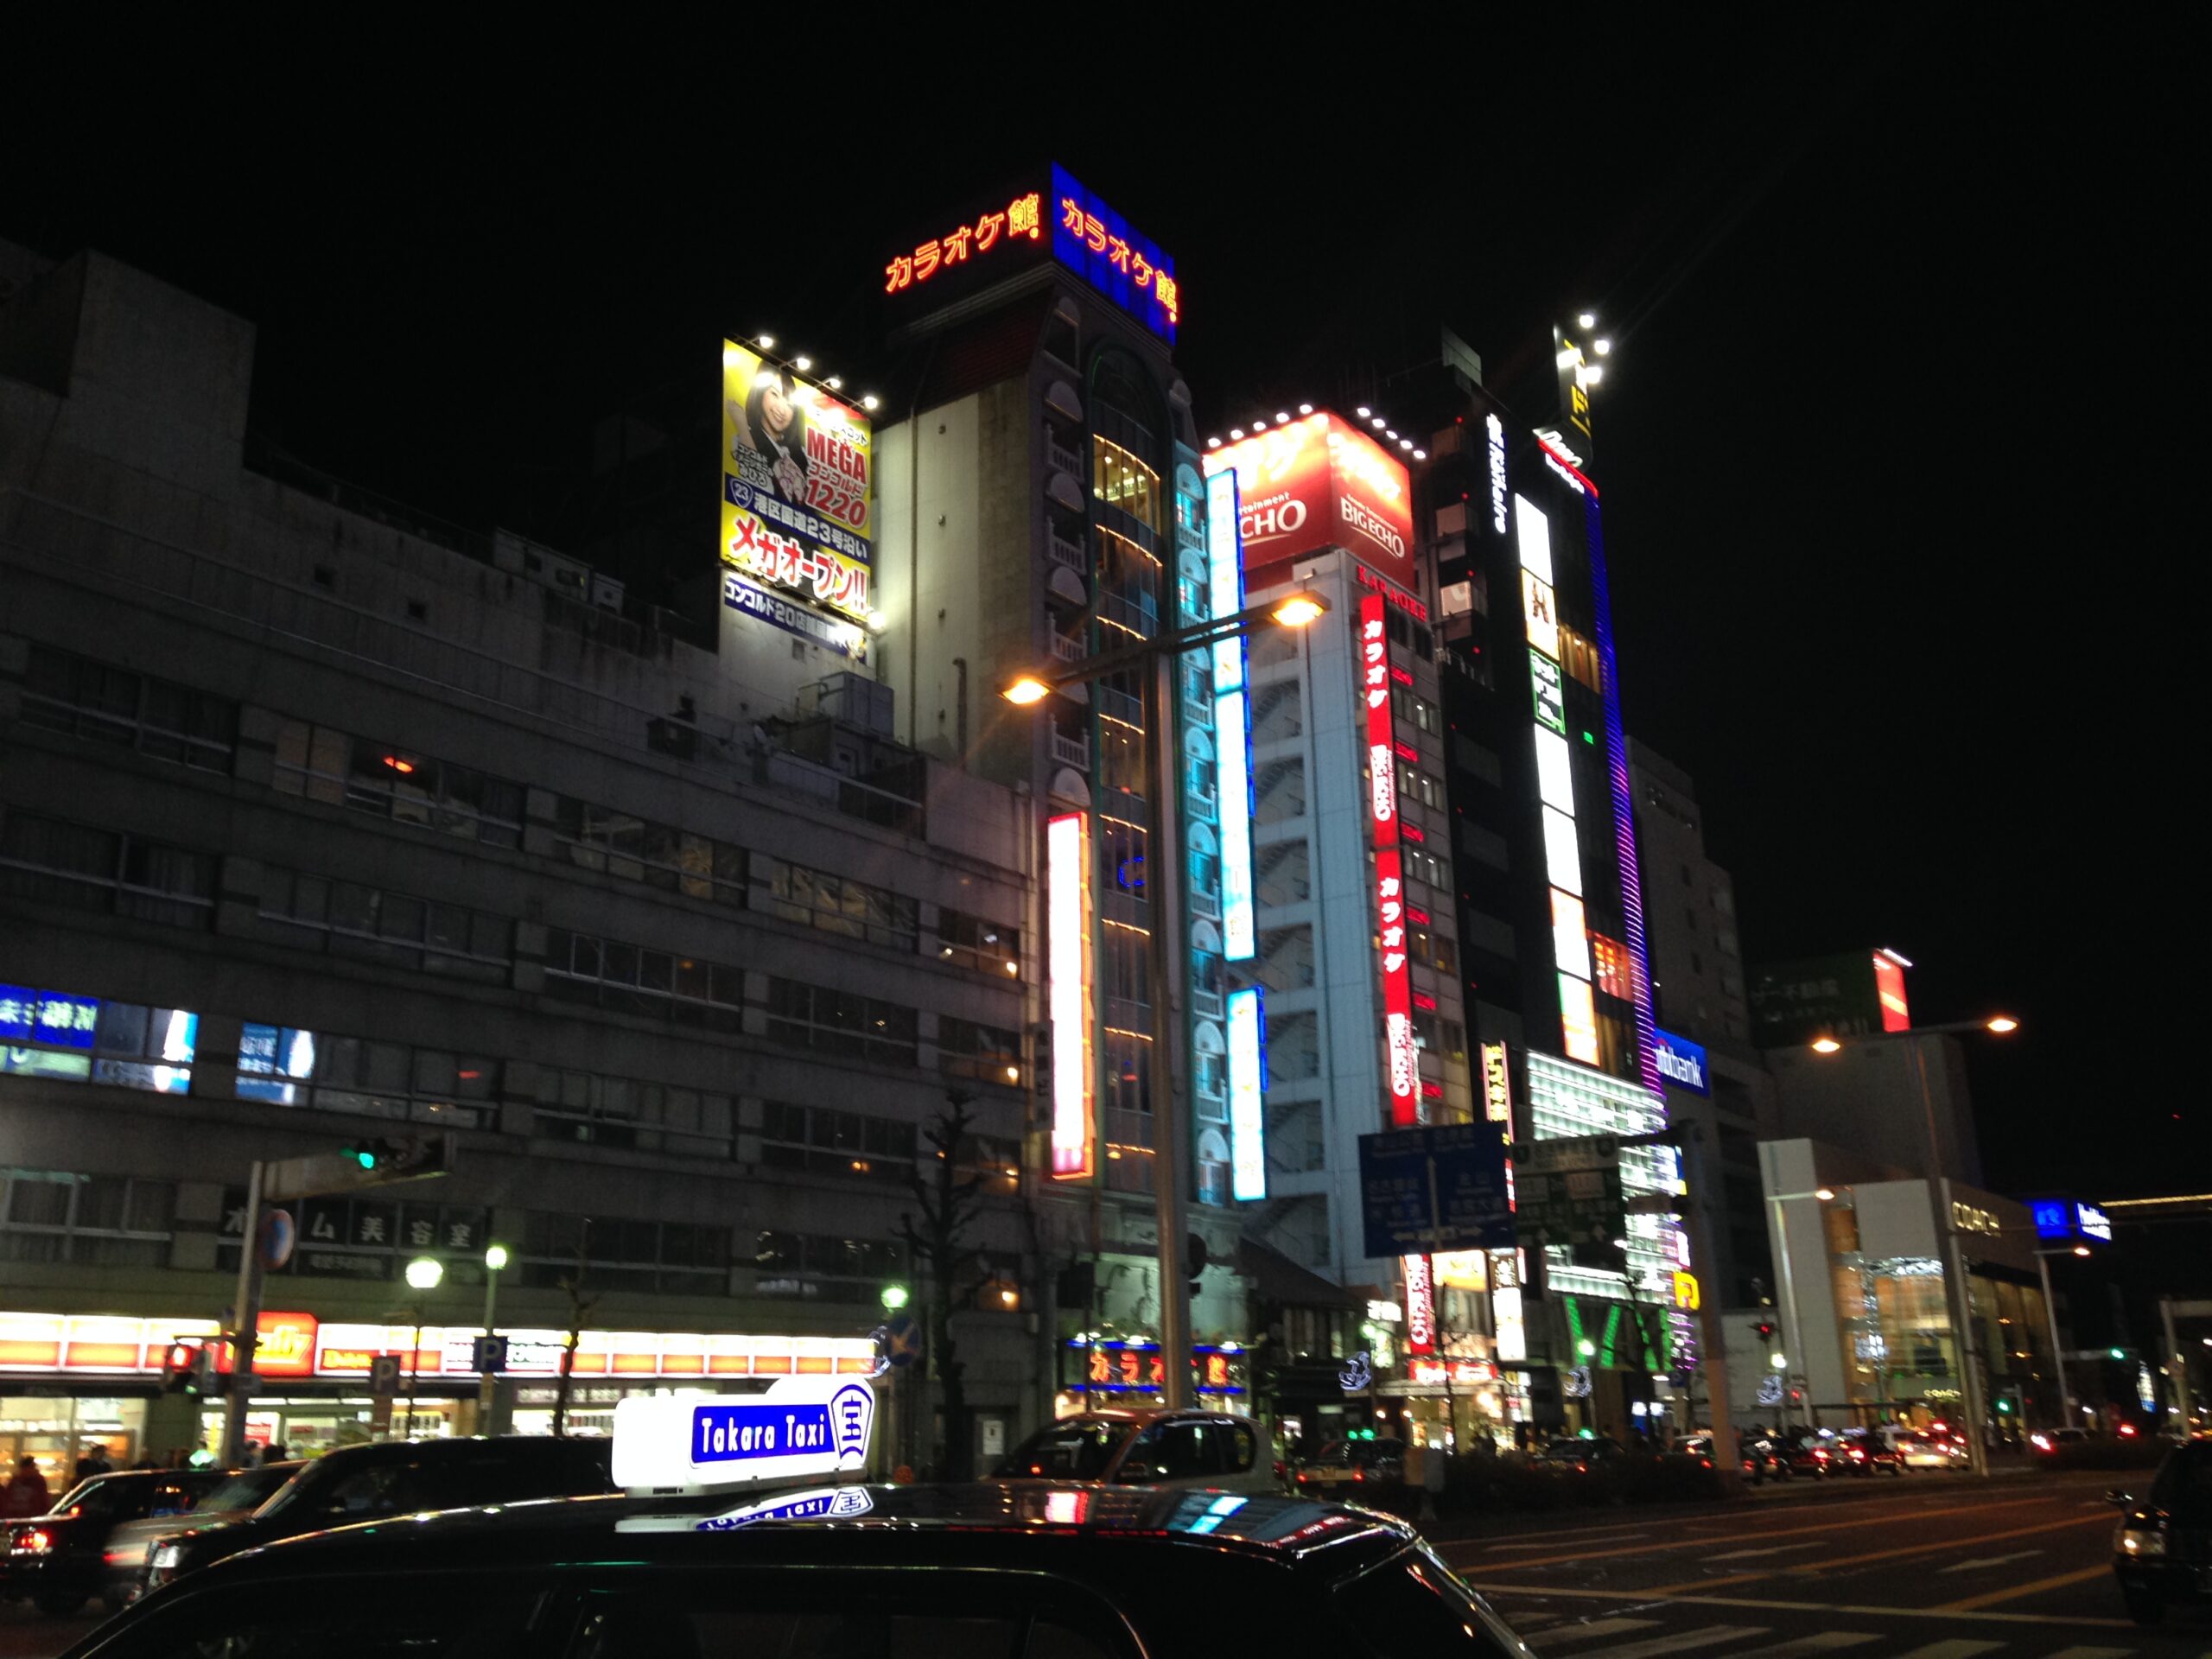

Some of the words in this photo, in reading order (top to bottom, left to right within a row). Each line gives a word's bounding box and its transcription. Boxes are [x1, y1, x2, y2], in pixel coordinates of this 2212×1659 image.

[885, 194, 1039, 292] カラオケ館
[1062, 198, 1179, 314] カラオケ館
[807, 427, 867, 485] MEGA
[806, 479, 866, 526] 1220
[1363, 620, 1388, 709] カラオケ
[1379, 877, 1406, 973] カラオケ
[702, 1416, 775, 1453] Takara
[785, 1413, 826, 1448] Taxi
